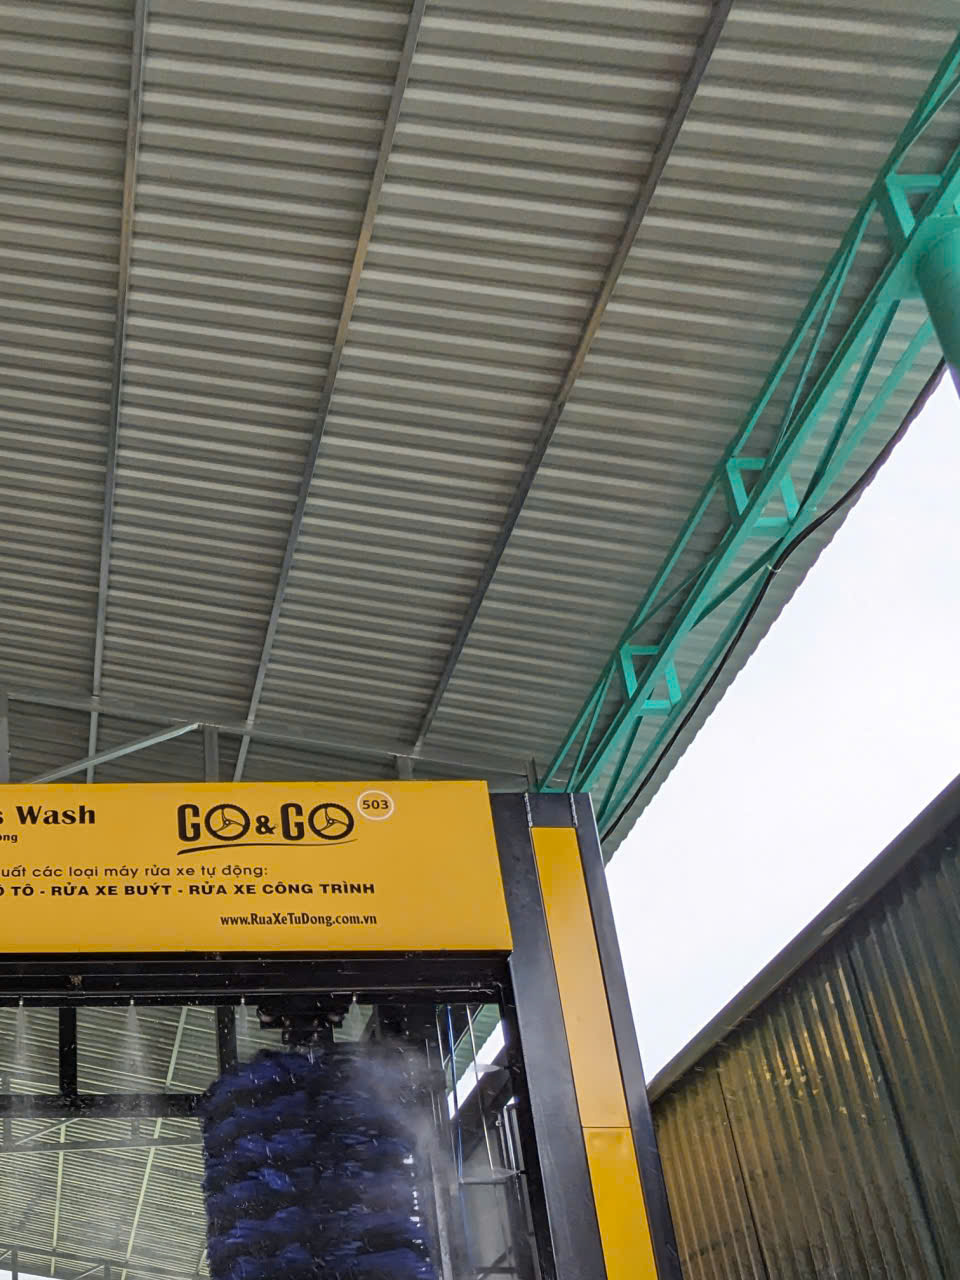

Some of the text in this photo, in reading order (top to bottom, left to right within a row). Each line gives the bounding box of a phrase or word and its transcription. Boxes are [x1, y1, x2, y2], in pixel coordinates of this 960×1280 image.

[362, 800, 389, 810] 503
[16, 805, 95, 825] Wash
[32, 865, 63, 877] các
[69, 866, 98, 879] loại
[104, 865, 139, 878] máy
[144, 864, 171, 876] rửa
[176, 867, 195, 876] xe
[201, 865, 216, 878] tự
[222, 864, 268, 877] động:
[11, 884, 34, 896] TÔ
[51, 882, 89, 896] RỬA
[96, 886, 118, 896] XE
[124, 883, 172, 895] BUÝT
[189, 881, 227, 895] RỬA
[234, 885, 257, 894] XE
[262, 882, 313, 894] CÔNG
[319, 881, 375, 894] TRÌNH
[220, 913, 377, 927] www.RuaXeTuDong.com.vn
